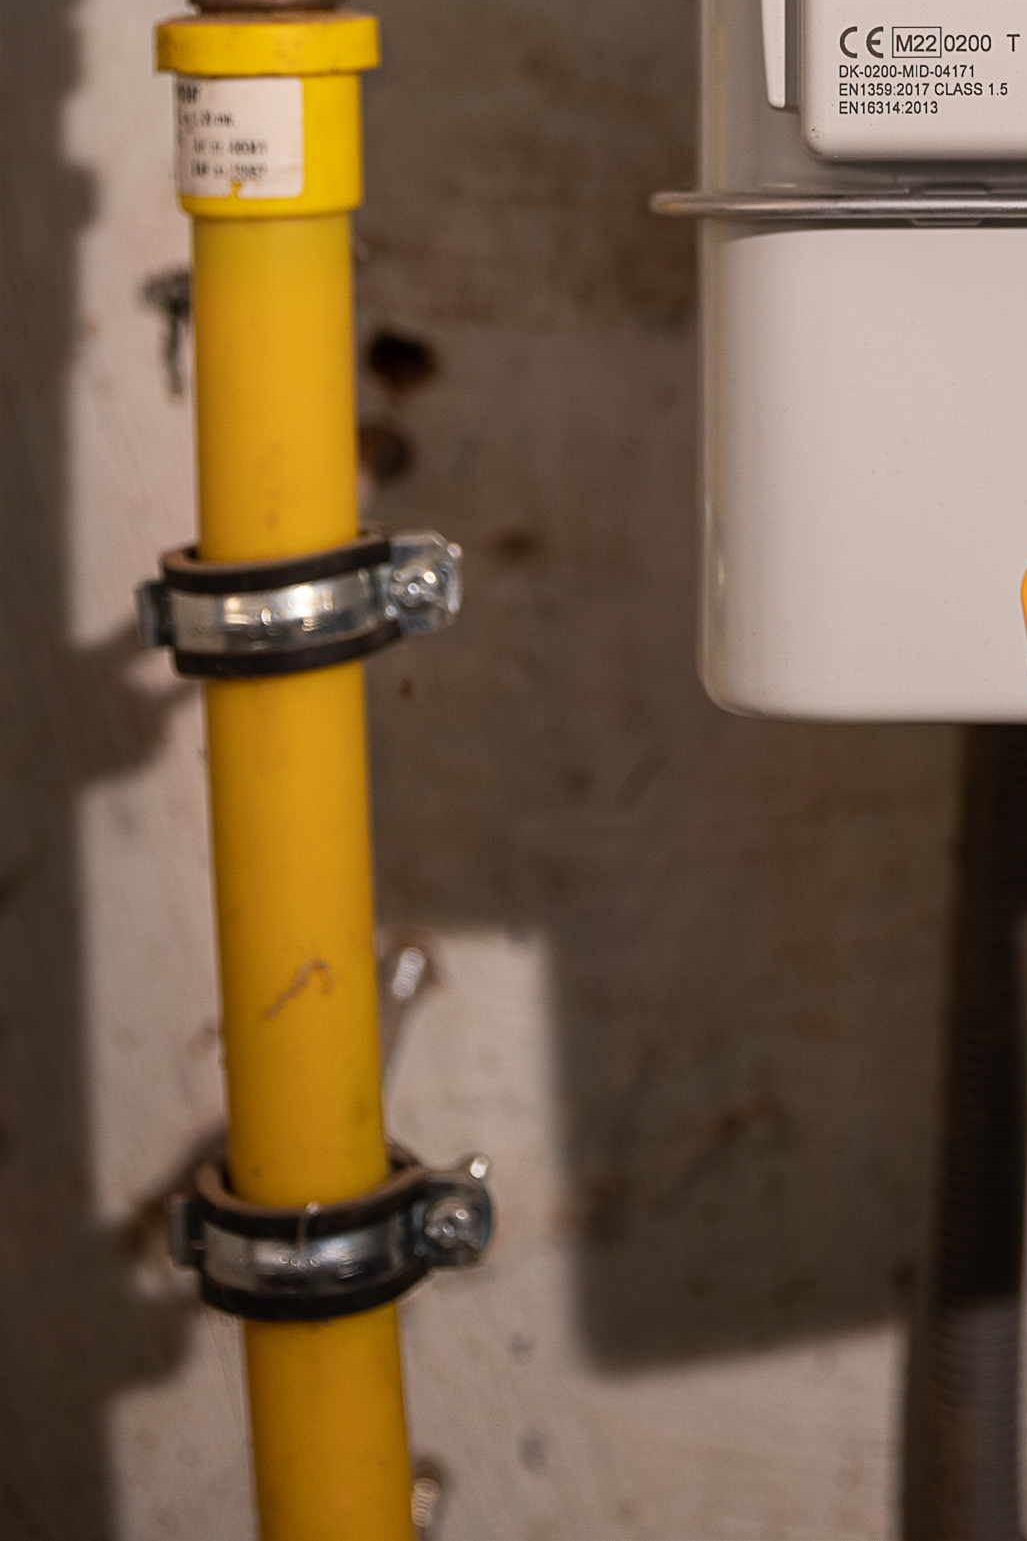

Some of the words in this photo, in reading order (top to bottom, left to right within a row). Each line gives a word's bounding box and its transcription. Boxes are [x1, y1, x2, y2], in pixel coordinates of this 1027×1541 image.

[896, 34, 937, 52] M22
[944, 34, 992, 52] 0200
[1006, 34, 1020, 52] T
[839, 65, 974, 78] DK-0200-MID-04171
[839, 83, 929, 96] EN1359:2017
[934, 83, 983, 96] CLASS
[988, 83, 1008, 96] 1.5
[839, 101, 938, 114] EN16314:2013
